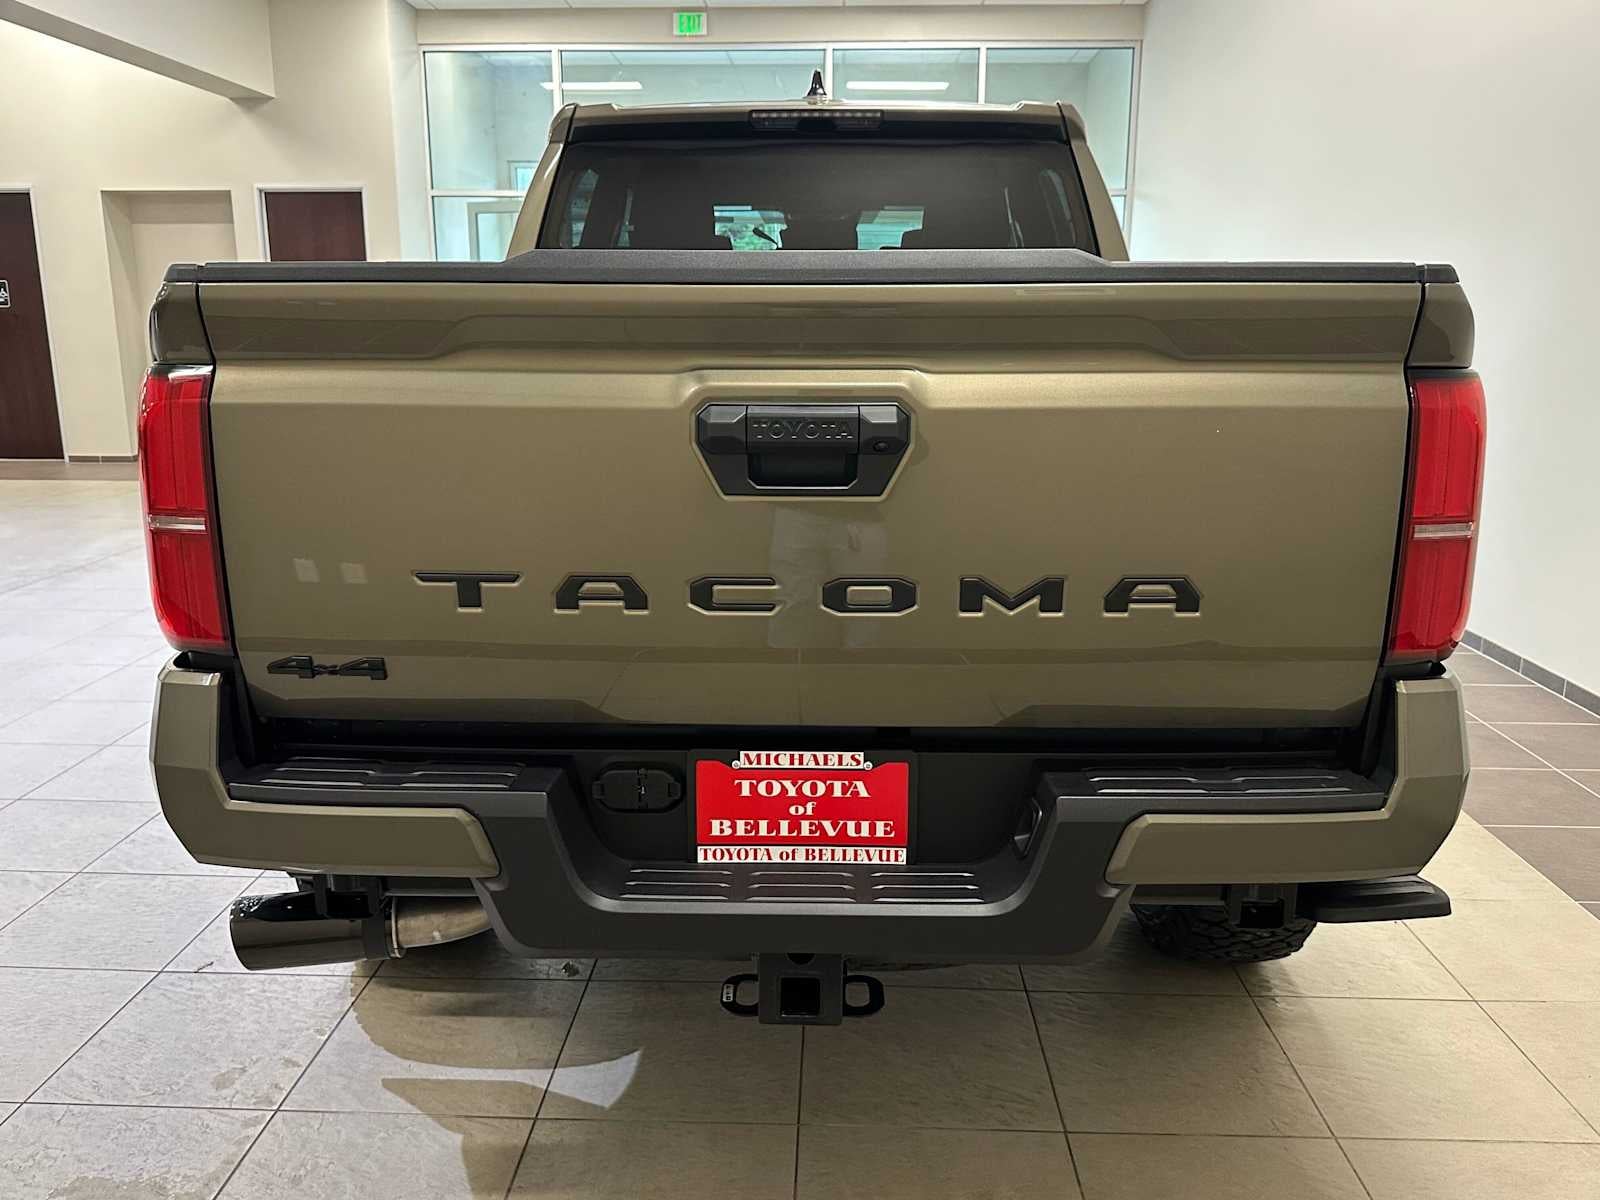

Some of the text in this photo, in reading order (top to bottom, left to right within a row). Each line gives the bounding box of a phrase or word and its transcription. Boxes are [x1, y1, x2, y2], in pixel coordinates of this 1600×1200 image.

[679, 15, 703, 33] EXIT
[752, 419, 854, 439] TOYOTA
[411, 571, 1204, 618] TACOMA
[743, 753, 862, 767] MICHAELS
[734, 779, 871, 798] TOYOTA
[788, 801, 816, 816] of
[709, 819, 895, 837] BELLEVUE
[701, 848, 905, 863] TOYOTA of BELLEVUE
